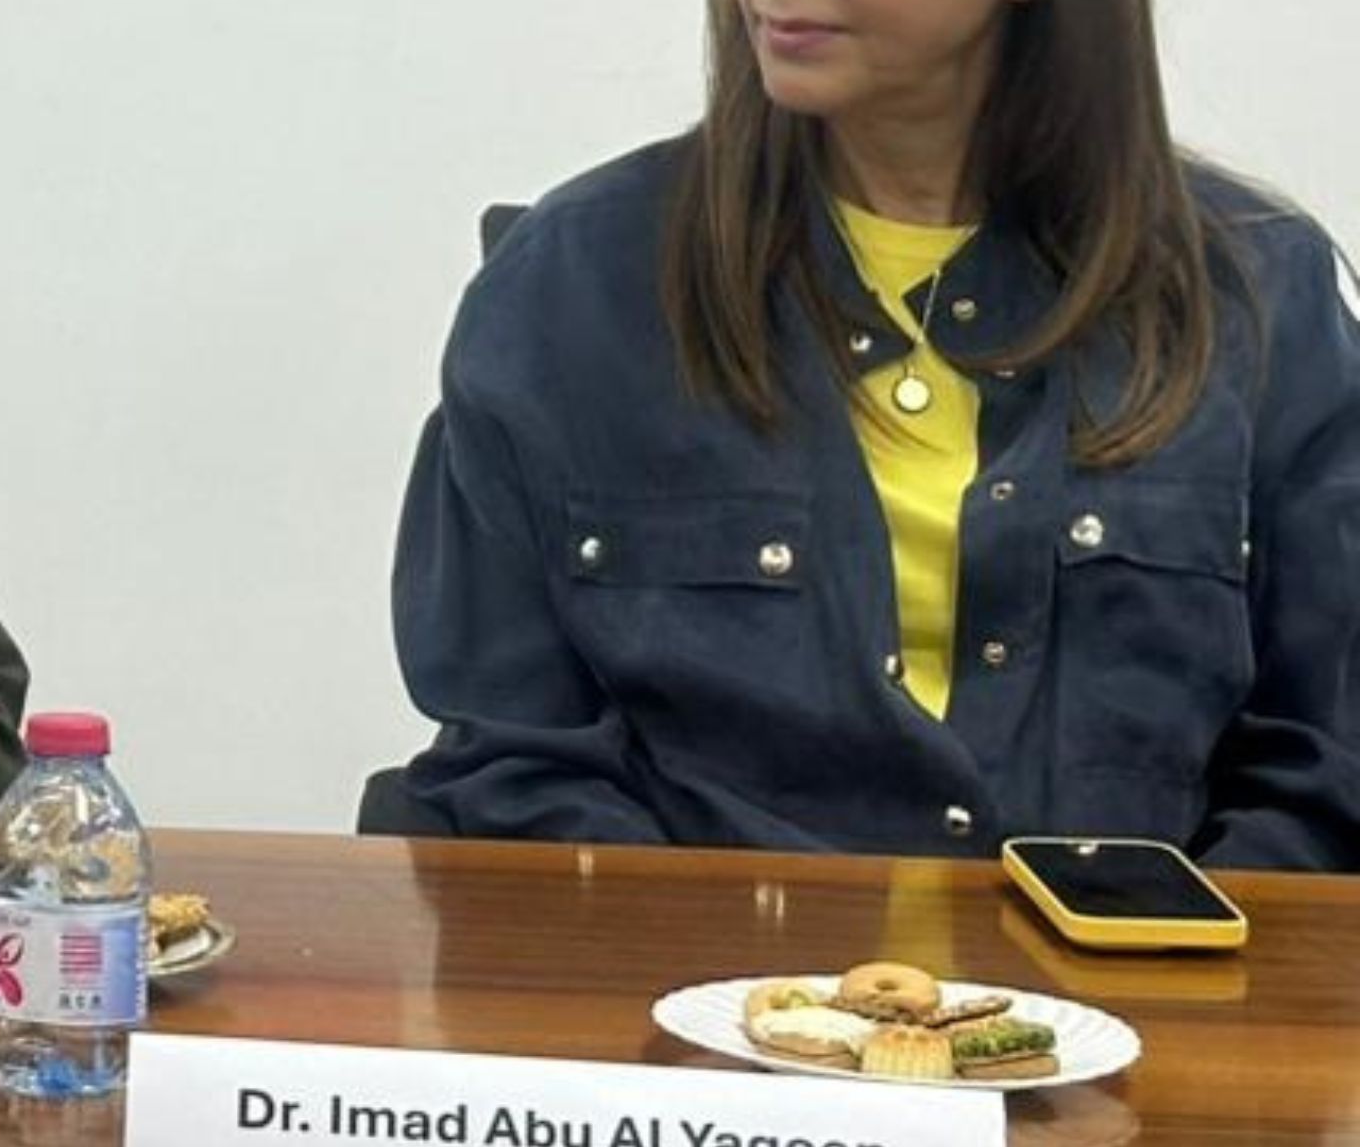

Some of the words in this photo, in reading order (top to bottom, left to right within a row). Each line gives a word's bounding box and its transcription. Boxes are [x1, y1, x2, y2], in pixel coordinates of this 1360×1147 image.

[237, 1087, 310, 1133] Dr.
[329, 1095, 467, 1144] Imad
[484, 1106, 592, 1147] Abu
